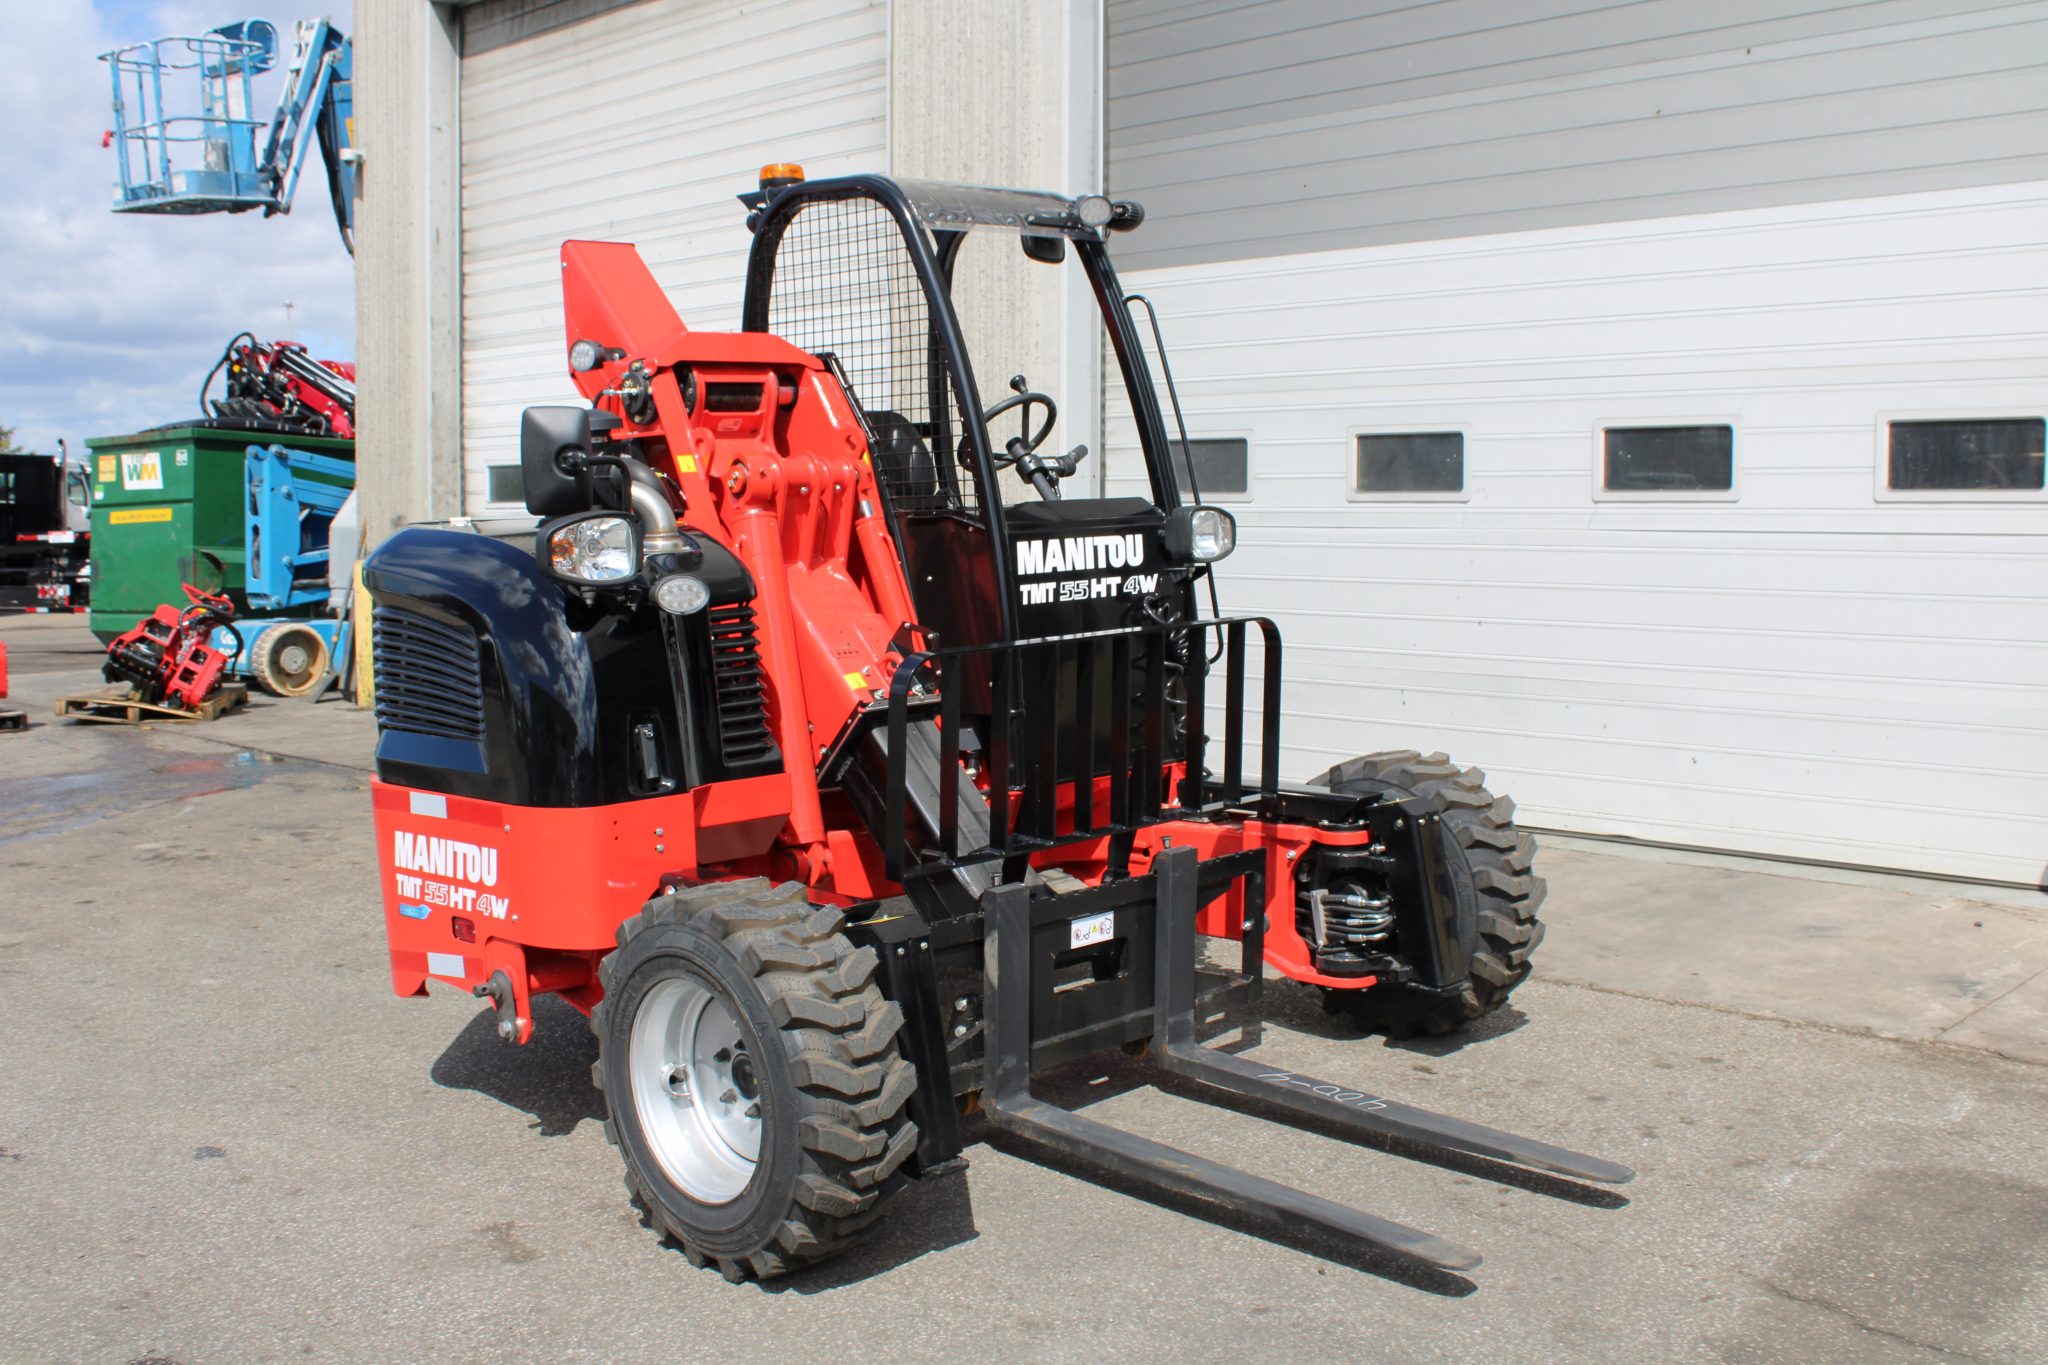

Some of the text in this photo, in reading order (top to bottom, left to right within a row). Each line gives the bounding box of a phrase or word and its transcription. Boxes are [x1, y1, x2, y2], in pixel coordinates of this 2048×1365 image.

[127, 464, 159, 480] WM
[1016, 534, 1144, 575] MANITOU
[1020, 582, 1056, 605] TMT
[1123, 573, 1158, 595] 4W
[394, 830, 497, 887] MANITOU
[395, 873, 422, 900] TMT
[476, 894, 509, 920] 4W
